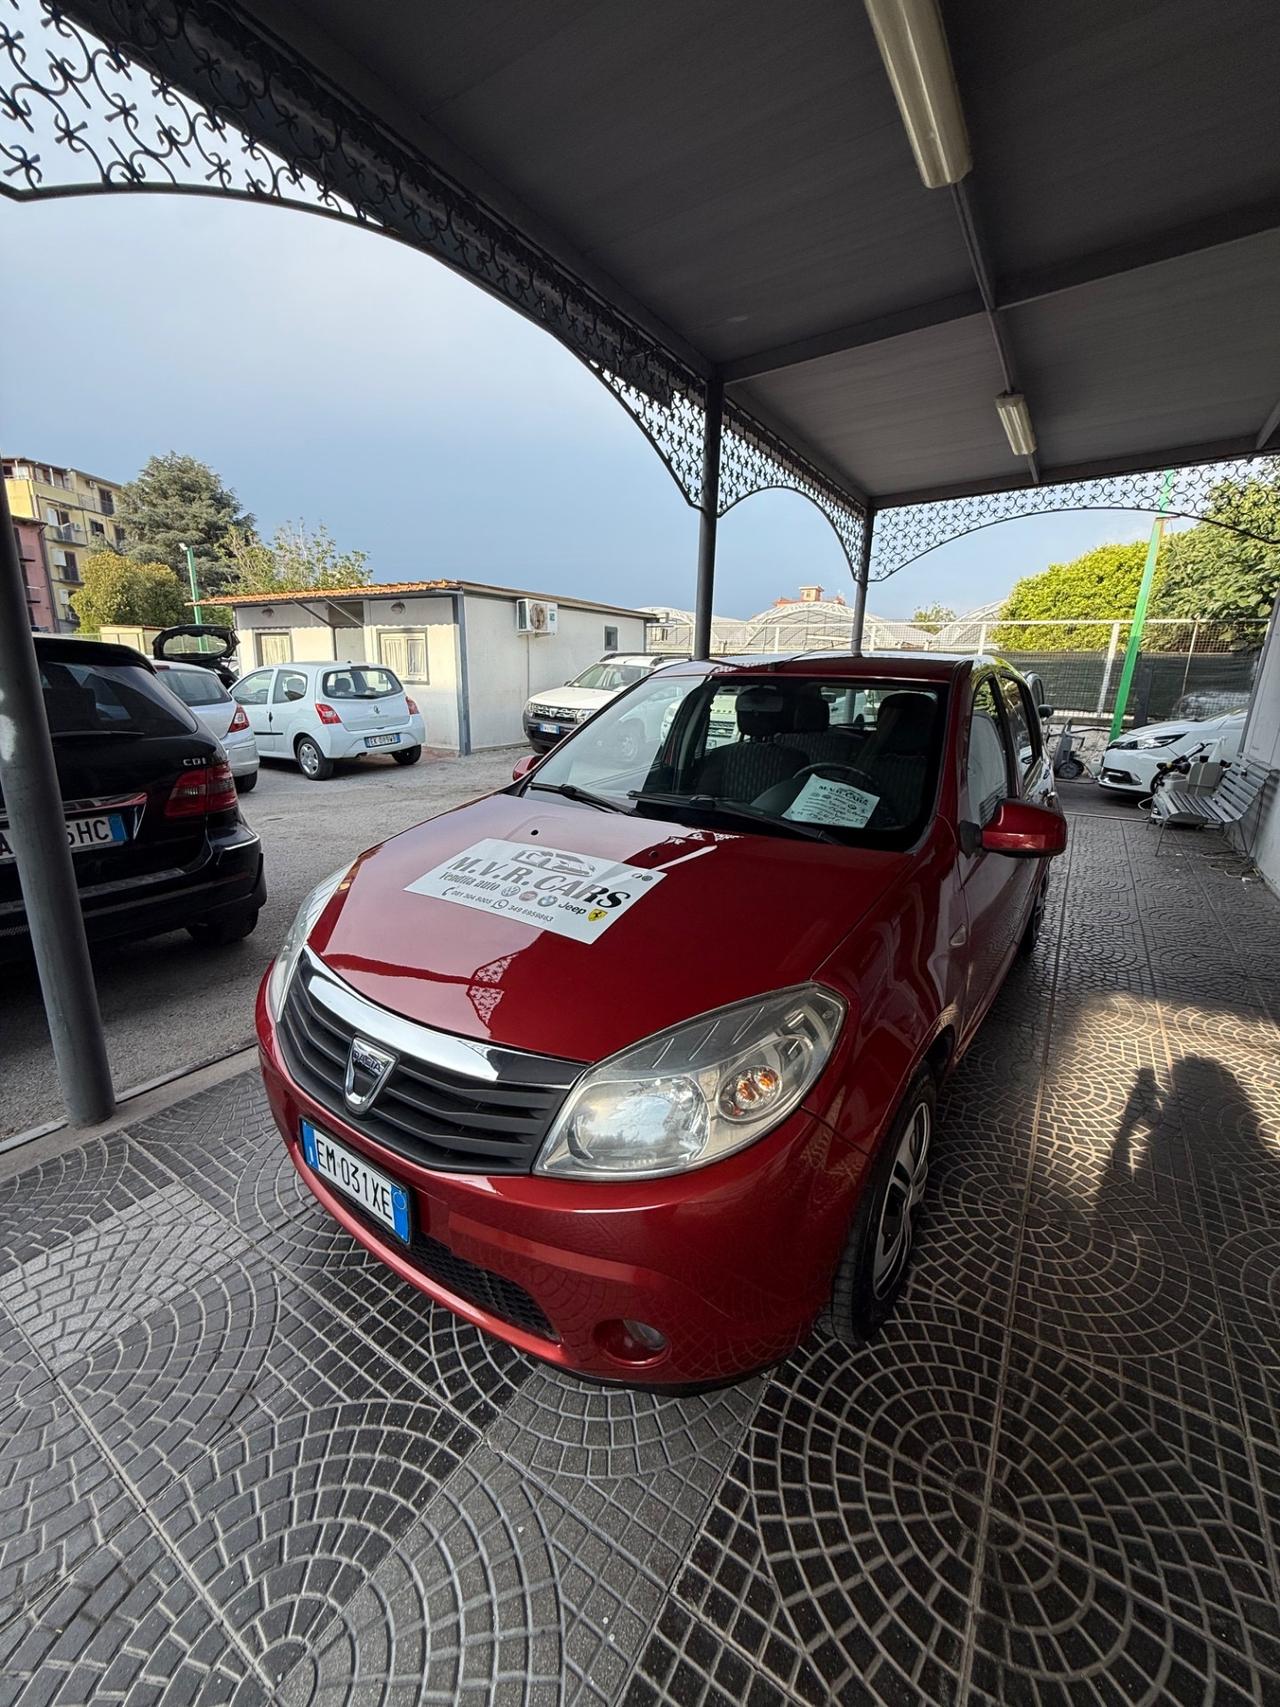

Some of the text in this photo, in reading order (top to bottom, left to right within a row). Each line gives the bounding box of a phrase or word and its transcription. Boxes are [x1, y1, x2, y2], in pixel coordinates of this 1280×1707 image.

[183, 757, 206, 766] CDI
[440, 872, 501, 892] Vendita auto
[533, 875, 631, 908] CARS
[558, 902, 587, 915] Jeep
[352, 1050, 382, 1073] DACIA
